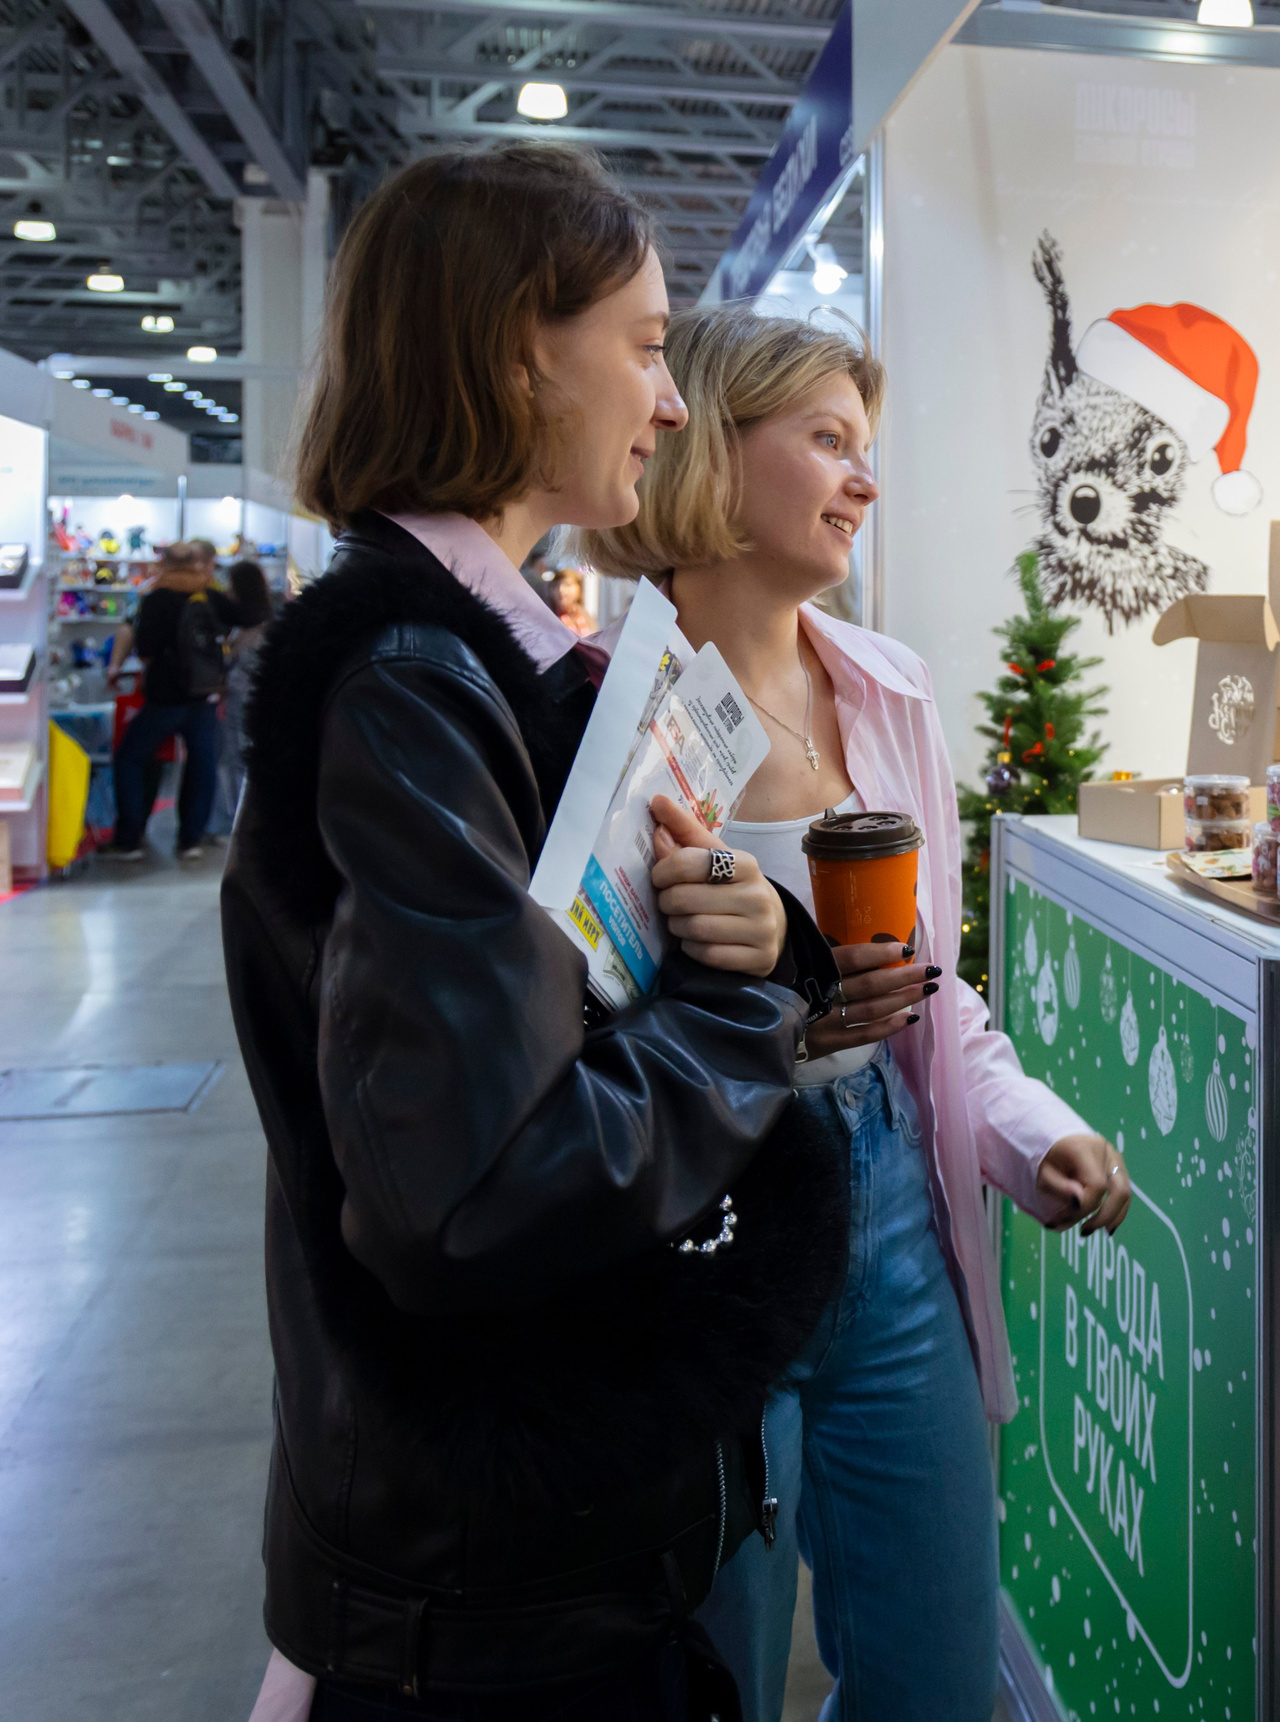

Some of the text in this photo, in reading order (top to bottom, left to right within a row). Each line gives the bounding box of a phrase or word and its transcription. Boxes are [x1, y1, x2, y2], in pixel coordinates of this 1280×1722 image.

[599, 880, 643, 960] ПОСЕТИТЕЛЬ
[608, 915, 626, 947] VISITOR
[1065, 1283, 1157, 1485] В ТВОИХ
[1073, 1393, 1145, 1579] РУКАХ
